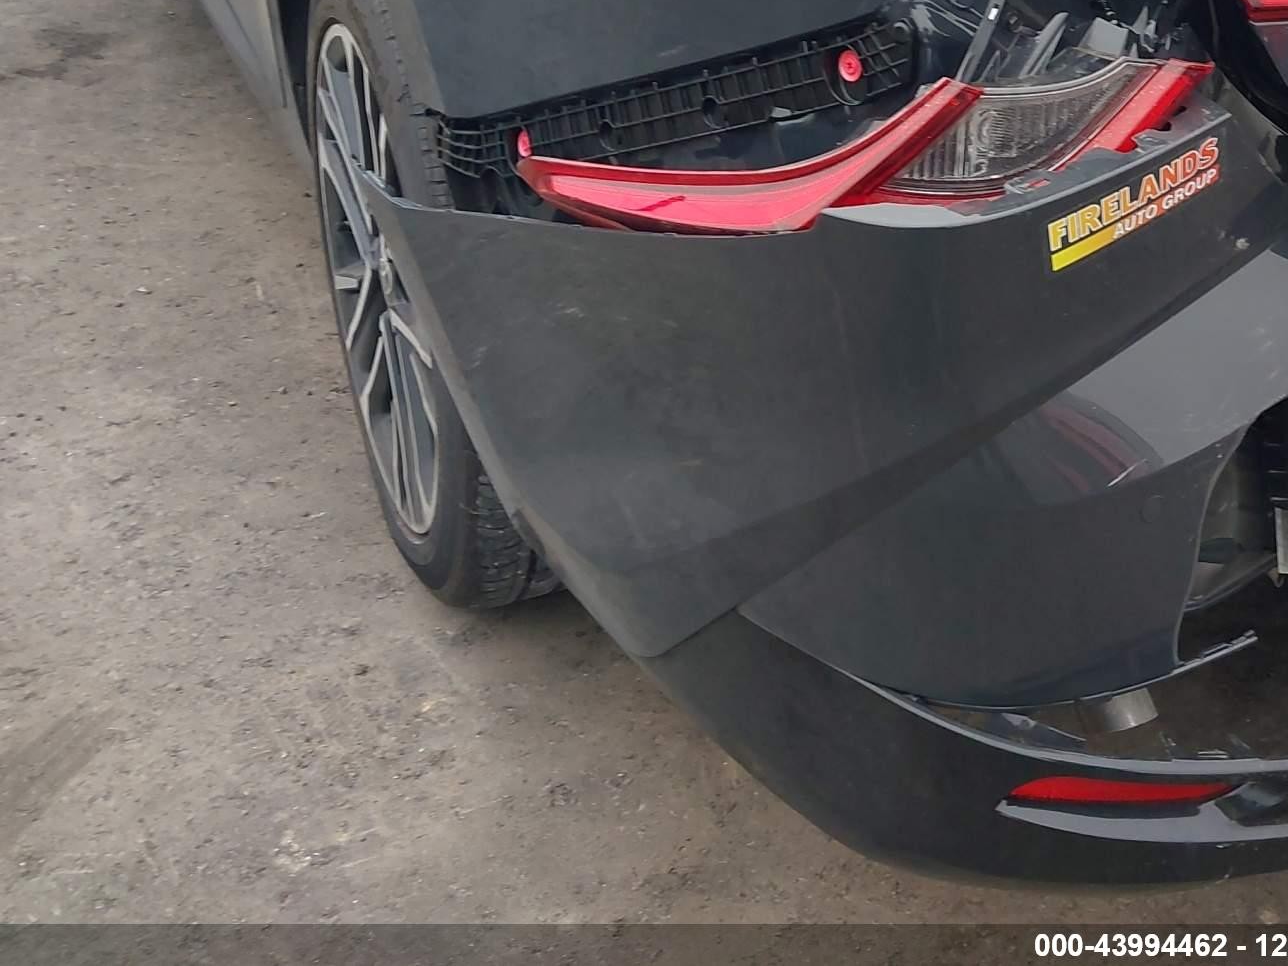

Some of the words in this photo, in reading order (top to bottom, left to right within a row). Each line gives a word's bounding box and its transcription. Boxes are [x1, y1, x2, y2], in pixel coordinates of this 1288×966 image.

[1048, 137, 1219, 251] FIRELANDS
[1113, 203, 1158, 239] AUTO
[1161, 168, 1218, 210] GROUP
